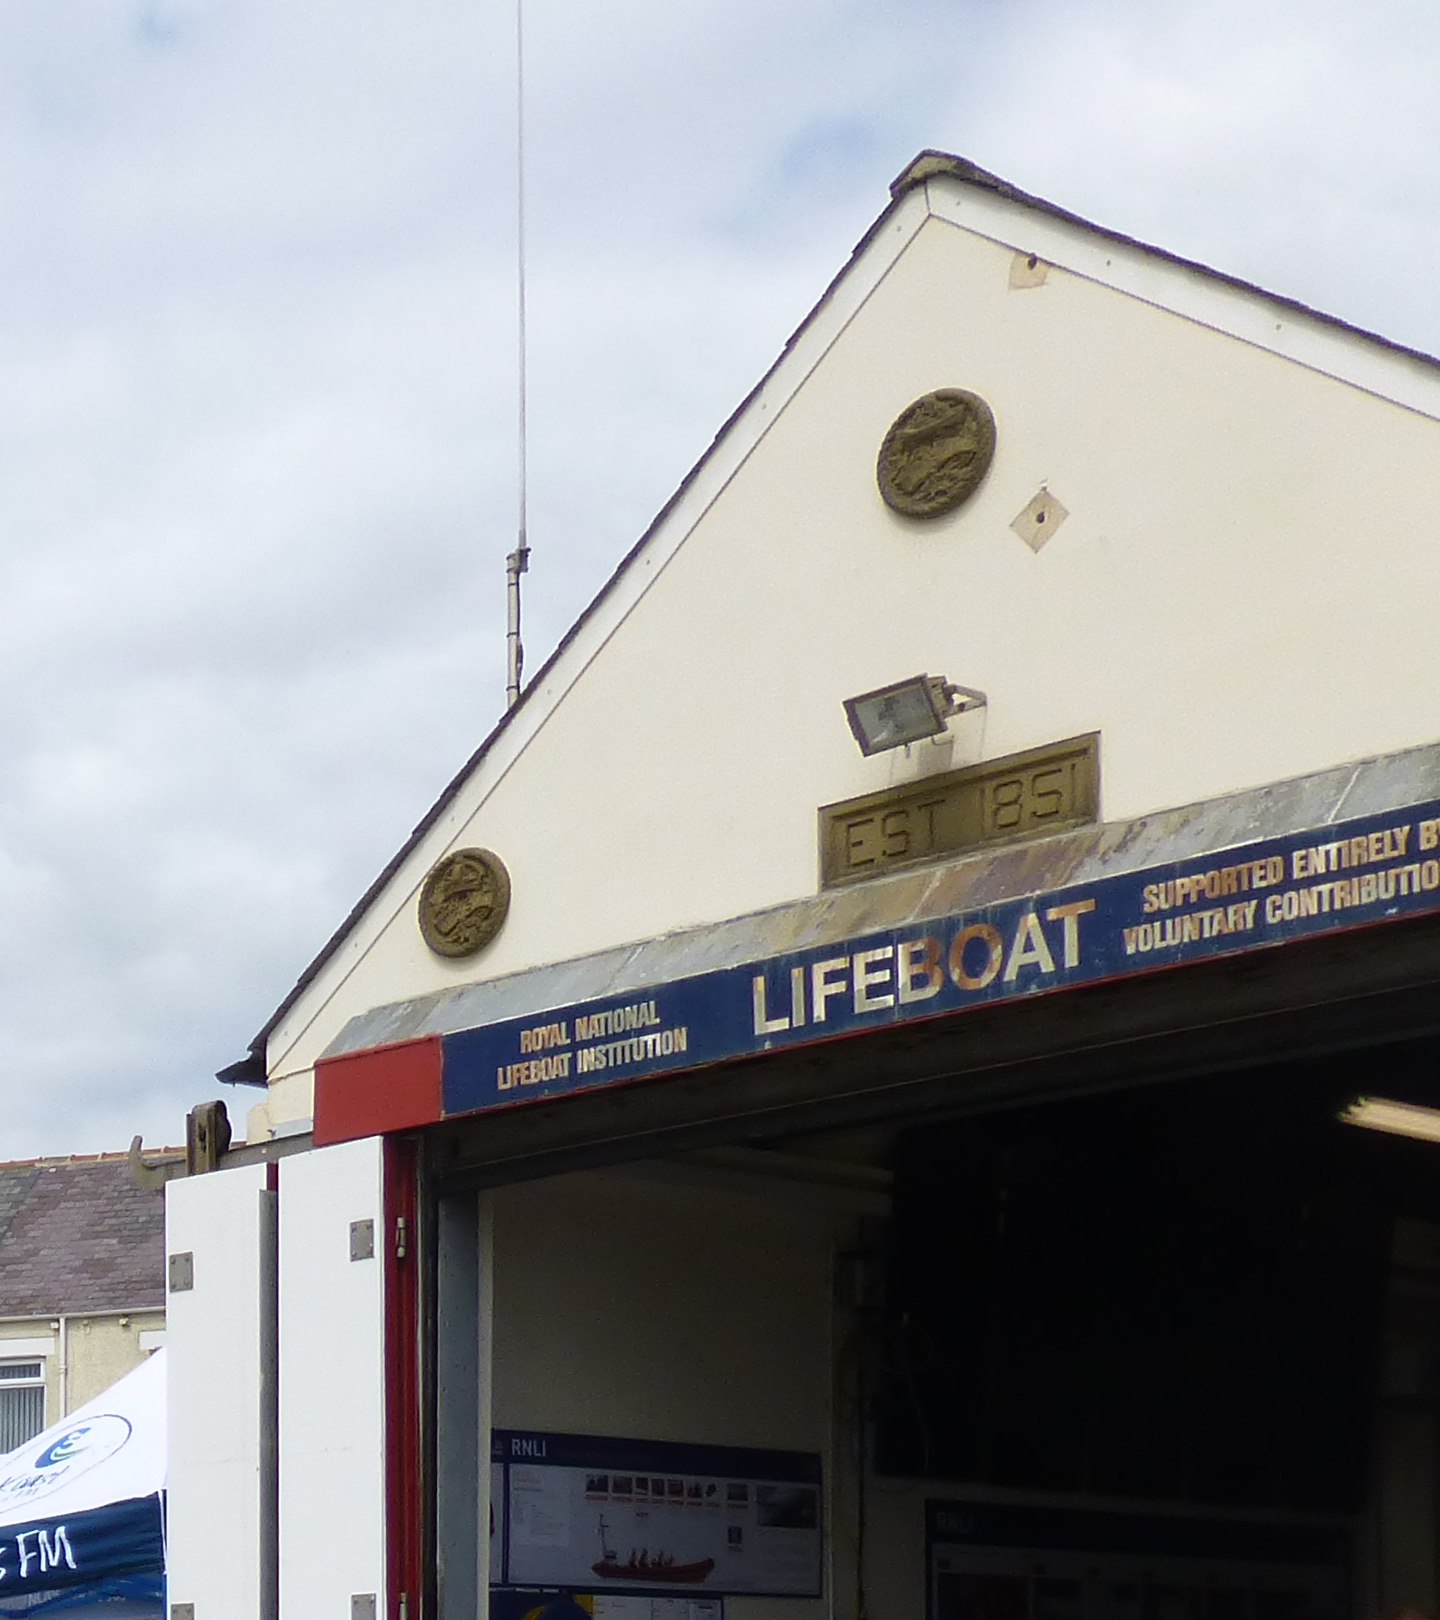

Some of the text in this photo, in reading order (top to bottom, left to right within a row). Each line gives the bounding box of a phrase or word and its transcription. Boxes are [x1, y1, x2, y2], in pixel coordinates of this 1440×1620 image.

[845, 762, 1077, 867] EST 1851
[1142, 818, 1440, 914] SUPPORTED ENTIRELY B
[1121, 899, 1259, 955] VOLUNTARY
[752, 898, 1096, 1036] LIFEBOAT
[520, 1000, 661, 1055] ROYAL NATIONAL
[497, 1026, 688, 1092] LIFEBOAT INSTITUTION
[511, 1437, 547, 1458] RNLI
[16, 1525, 78, 1579] FM
